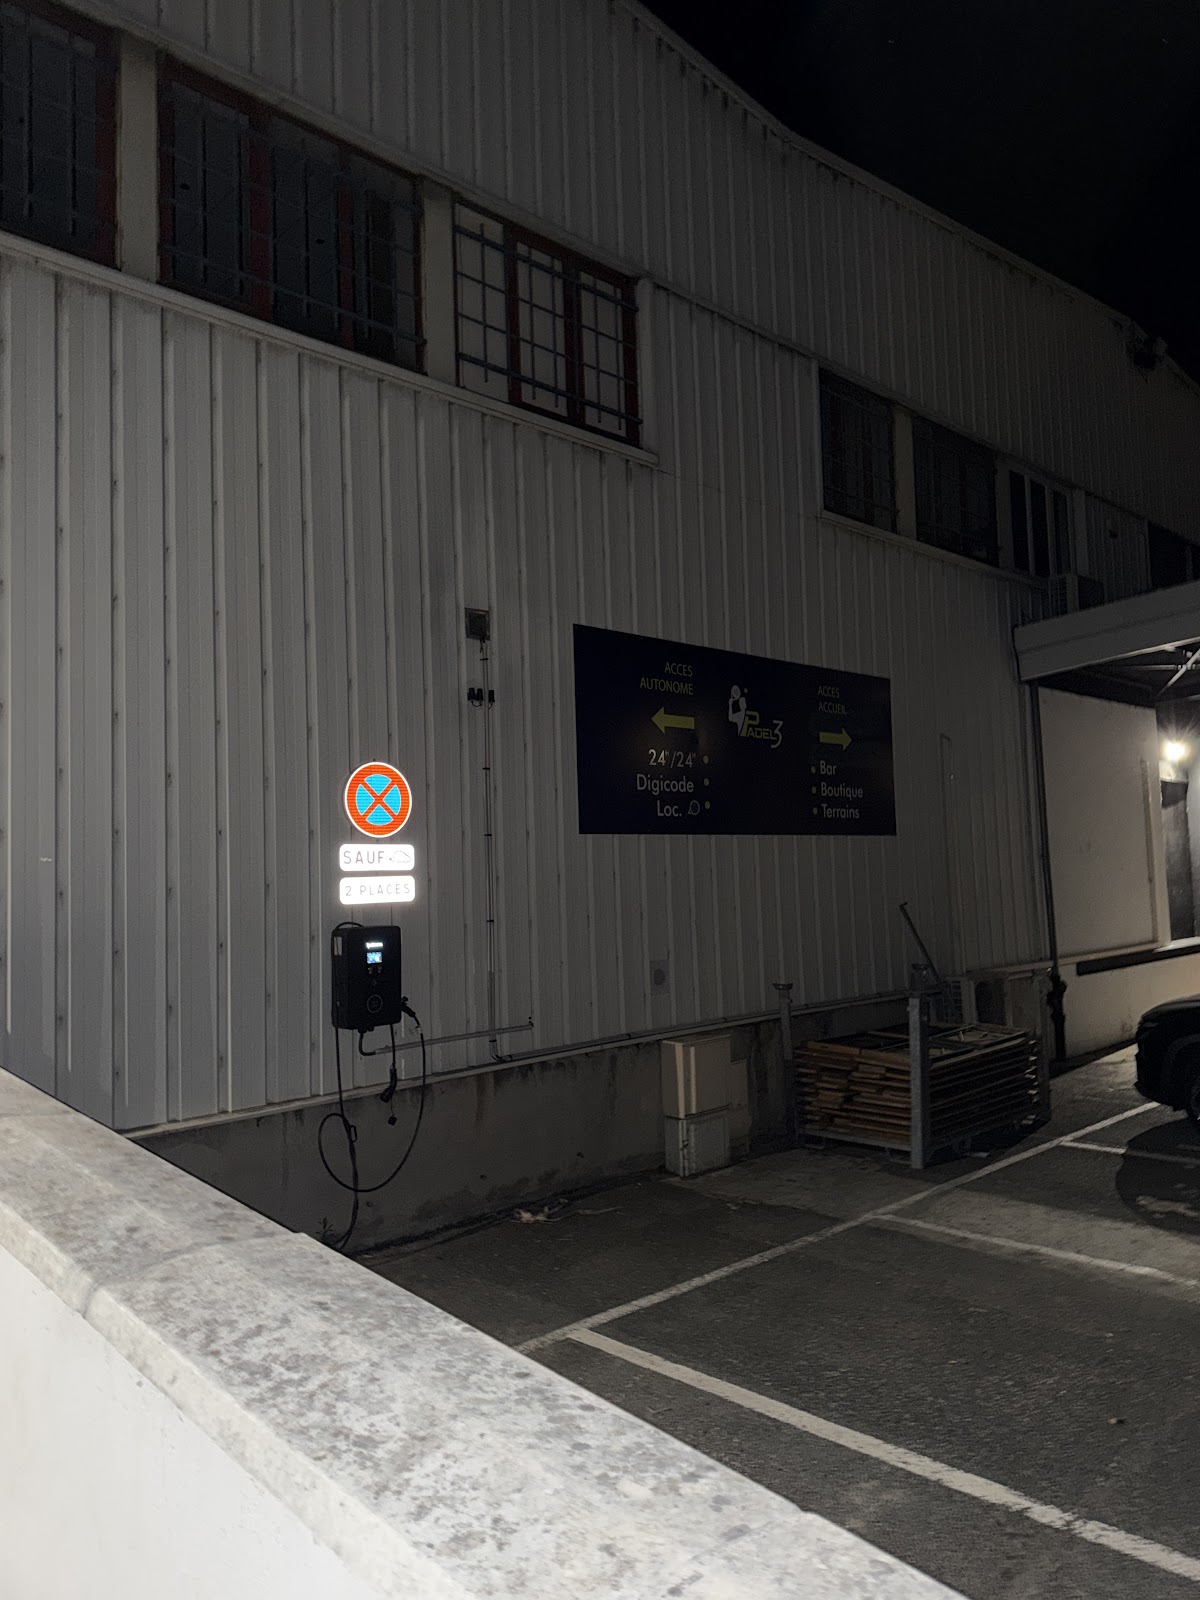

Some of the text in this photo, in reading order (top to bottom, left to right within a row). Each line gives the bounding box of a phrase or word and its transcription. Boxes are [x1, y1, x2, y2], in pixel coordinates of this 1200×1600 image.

[664, 662, 693, 677] ACCES
[639, 677, 694, 695] AUTONOME
[817, 685, 840, 698] ACCES
[818, 701, 847, 715] ACCUEIL
[820, 760, 837, 776] Bar
[636, 774, 695, 796] Digicode
[820, 782, 864, 800] Boutique
[656, 800, 683, 817] Loc.
[821, 803, 860, 819] Terrains
[343, 850, 385, 865] SAUF
[345, 884, 410, 897] 2 PLACES
